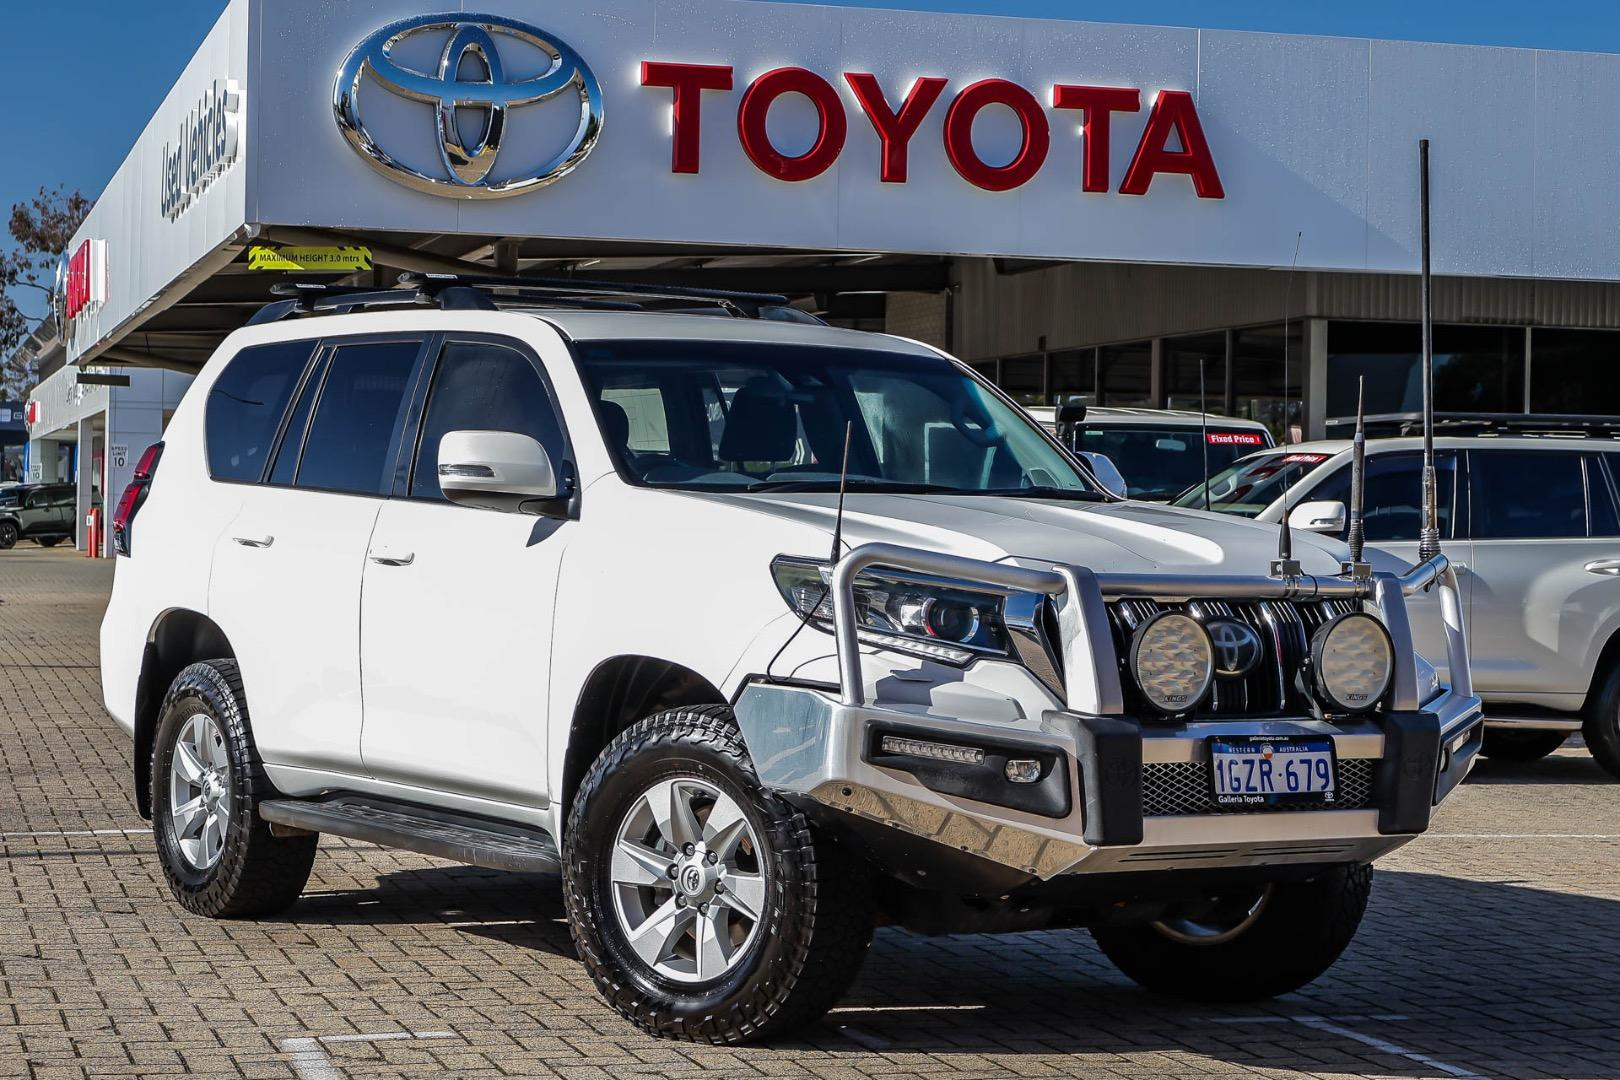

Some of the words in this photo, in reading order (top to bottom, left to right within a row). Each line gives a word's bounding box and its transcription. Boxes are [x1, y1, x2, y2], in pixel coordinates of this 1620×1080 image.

[641, 61, 1225, 199] TOYOTA
[161, 123, 183, 218] Used
[185, 79, 229, 192] Vehicles
[260, 254, 298, 262] MAXIMUM
[300, 254, 328, 262] HEIGHT
[1211, 435, 1233, 443] Fixed
[1233, 435, 1255, 443] Price
[114, 457, 125, 467] 10
[1163, 695, 1187, 703] KINGS
[1218, 795, 1243, 803] Galleria
[1243, 795, 1265, 803] Toyota
